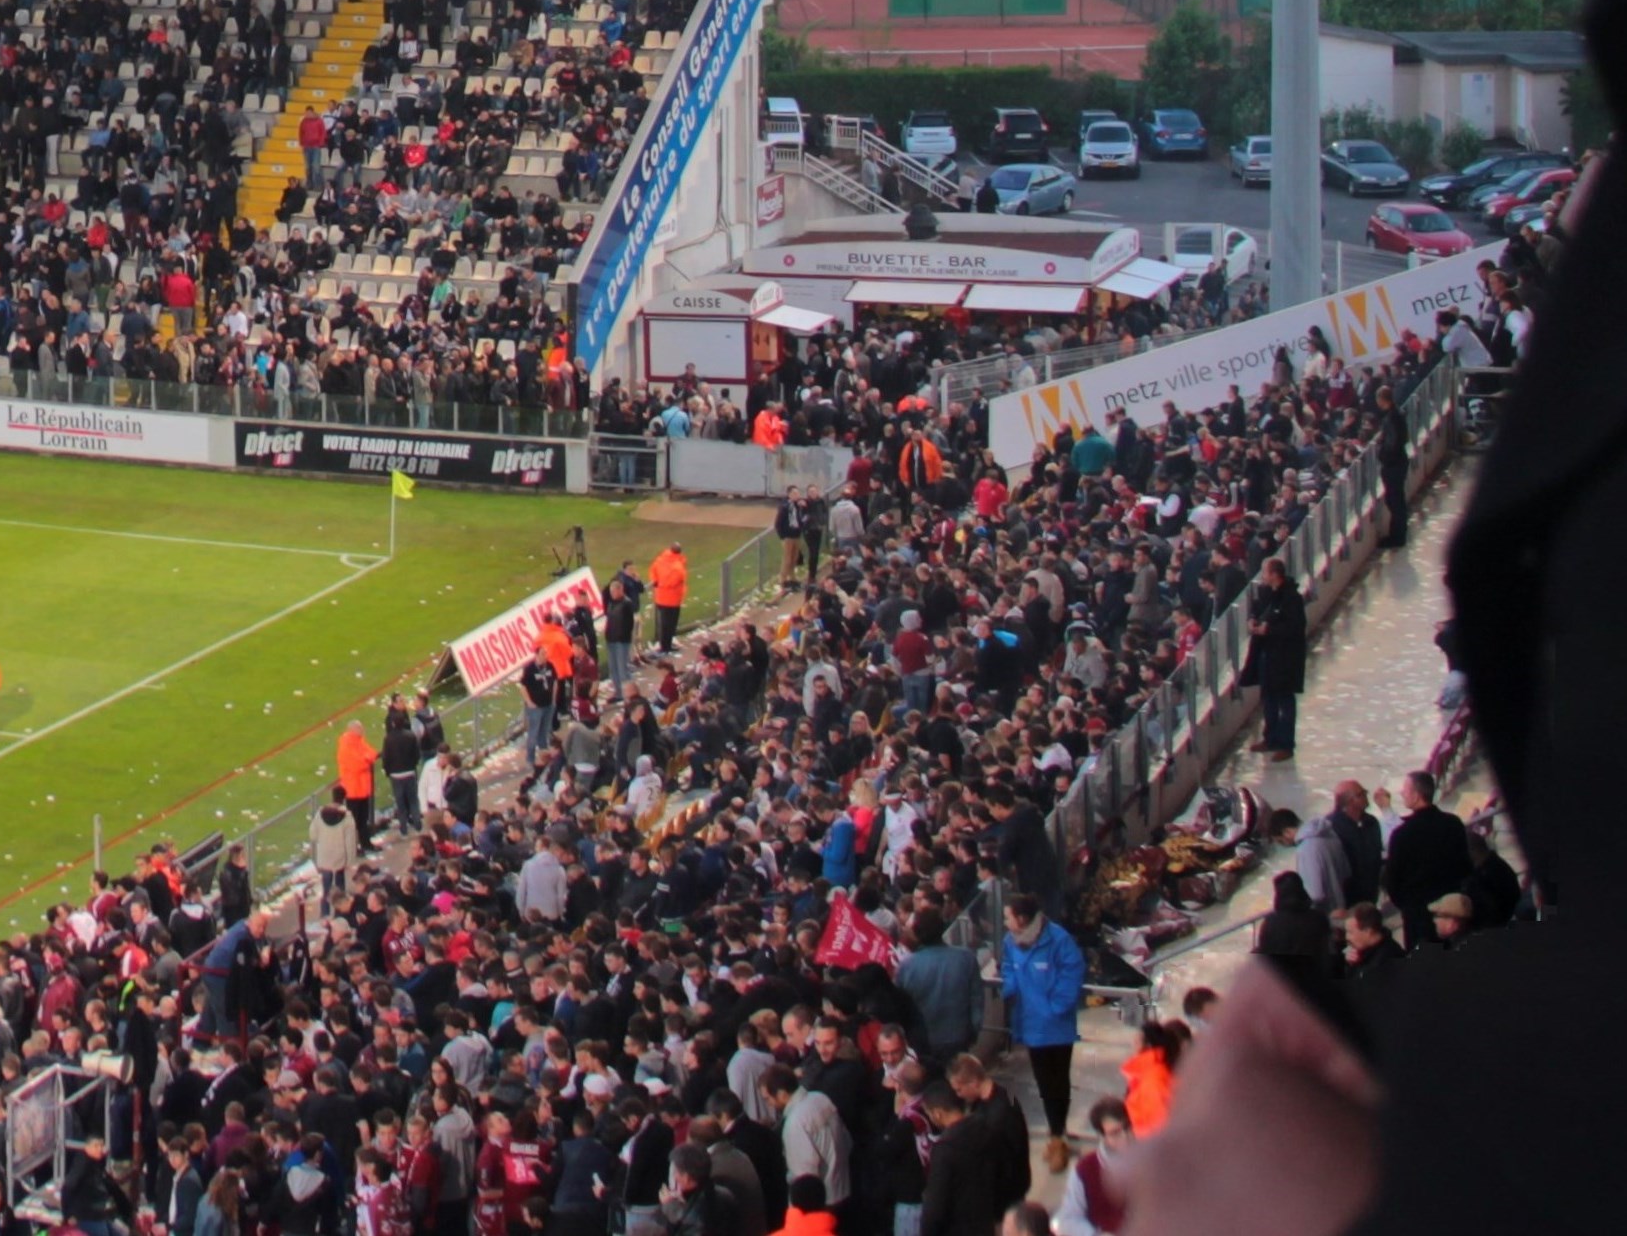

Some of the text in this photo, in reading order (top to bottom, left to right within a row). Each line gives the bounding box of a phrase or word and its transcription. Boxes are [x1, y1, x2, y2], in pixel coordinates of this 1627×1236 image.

[622, 185, 640, 224] Le
[641, 77, 689, 182] Conseil
[608, 149, 677, 313] partenaire
[679, 107, 696, 149] du
[698, 34, 731, 109] sport
[816, 264, 851, 272] PRENEZ
[876, 266, 909, 274] JETONS
[984, 268, 1018, 276] CAISSE
[848, 253, 986, 268] BUVETTE BAR
[673, 297, 721, 308] CAISSE
[1412, 284, 1472, 315] metz
[1103, 337, 1311, 412] metz ville sportive
[7, 405, 143, 434] Le Républicain
[40, 431, 108, 451] Lorrain
[323, 433, 471, 460] VOTRE RADIO EN LORRAINE
[348, 453, 386, 470] METZ
[419, 458, 439, 475] FM
[458, 616, 536, 687] MAISONS
